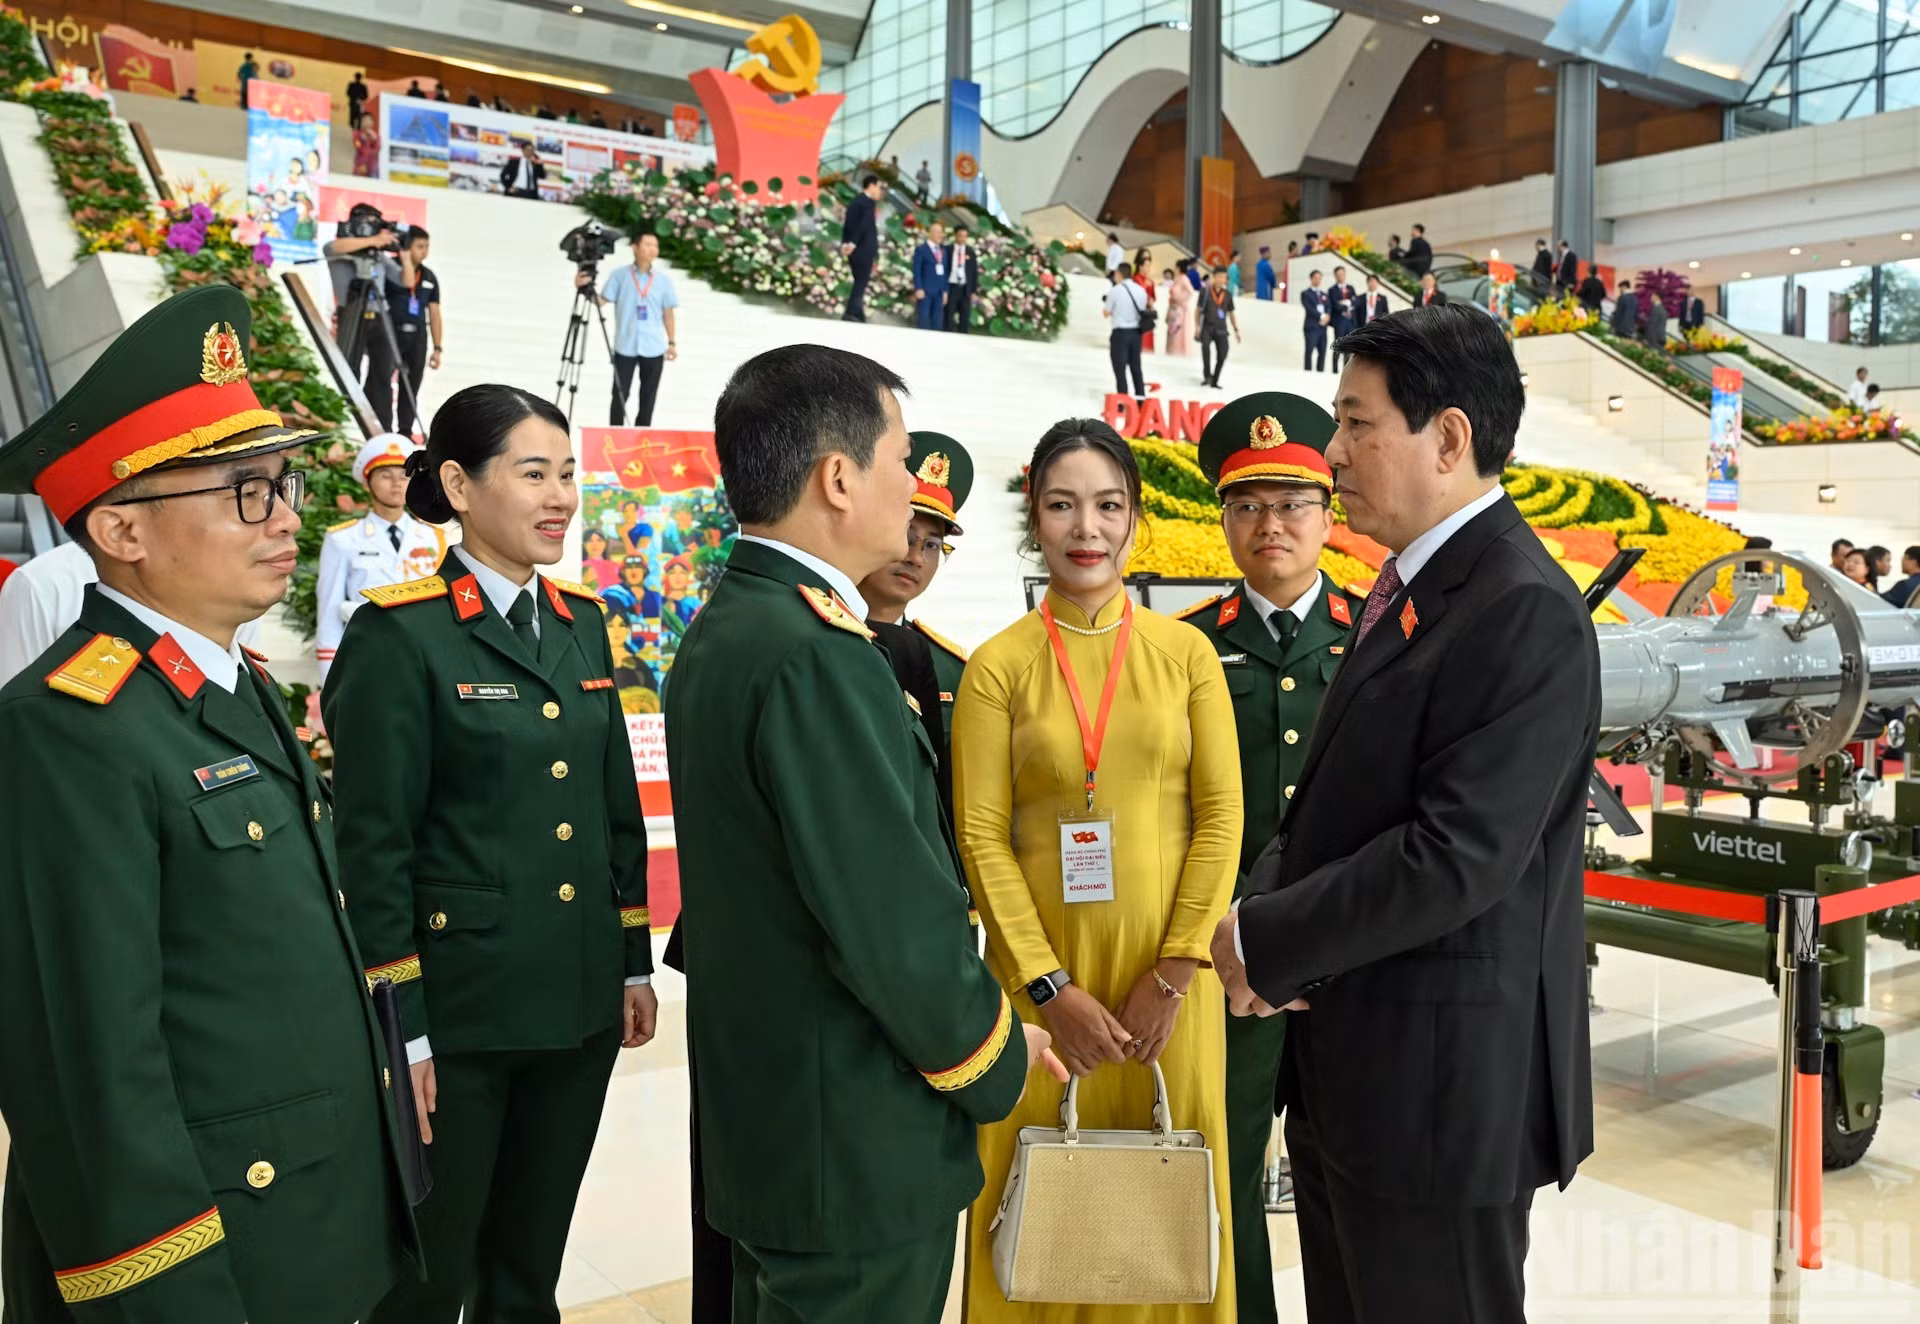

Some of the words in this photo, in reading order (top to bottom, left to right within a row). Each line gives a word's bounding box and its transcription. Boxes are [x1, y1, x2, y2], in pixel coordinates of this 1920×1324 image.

[30, 15, 89, 48] HỘI
[631, 720, 654, 730] KẾT
[631, 733, 658, 745] CHỦ
[1692, 830, 1787, 865] viettel
